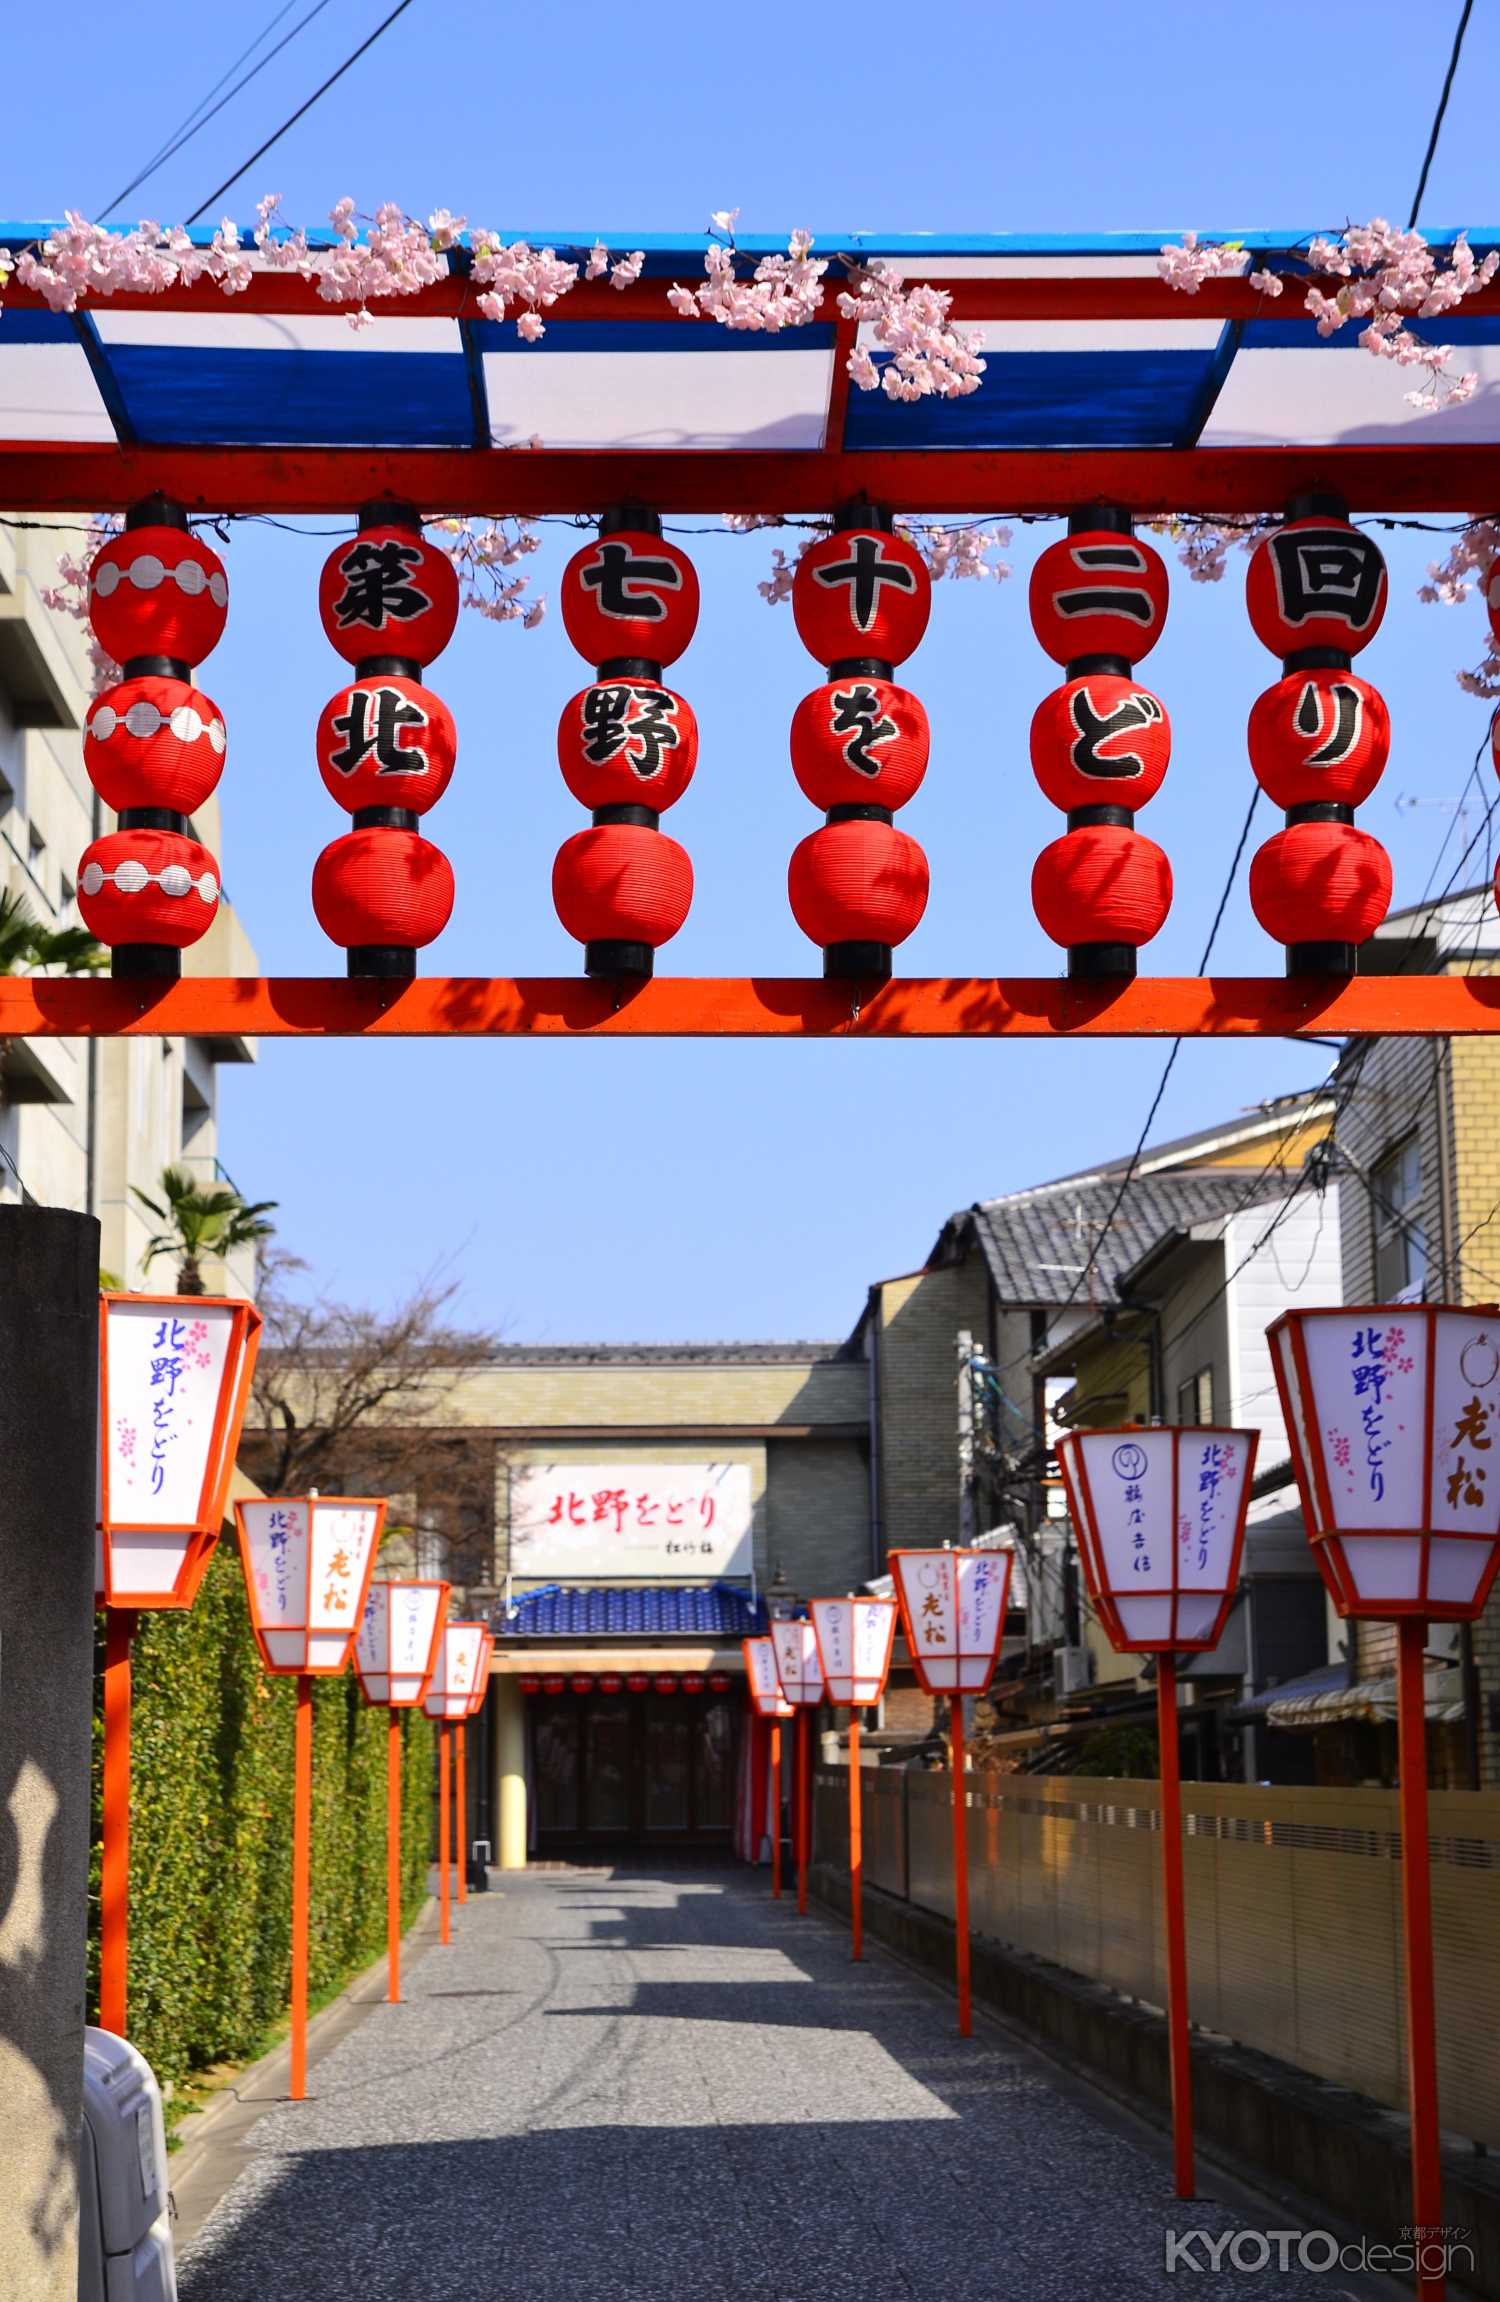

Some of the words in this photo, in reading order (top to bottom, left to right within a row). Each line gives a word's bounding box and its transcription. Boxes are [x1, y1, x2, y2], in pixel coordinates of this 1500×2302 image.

[329, 682, 1365, 782] 北野をどり
[150, 1318, 187, 1495] 北野をどり
[1351, 1327, 1393, 1502] 北野をどり
[1446, 1395, 1496, 1511] 老松
[547, 1488, 716, 1533] 北野をどり
[1199, 1444, 1221, 1571] 北野をどり
